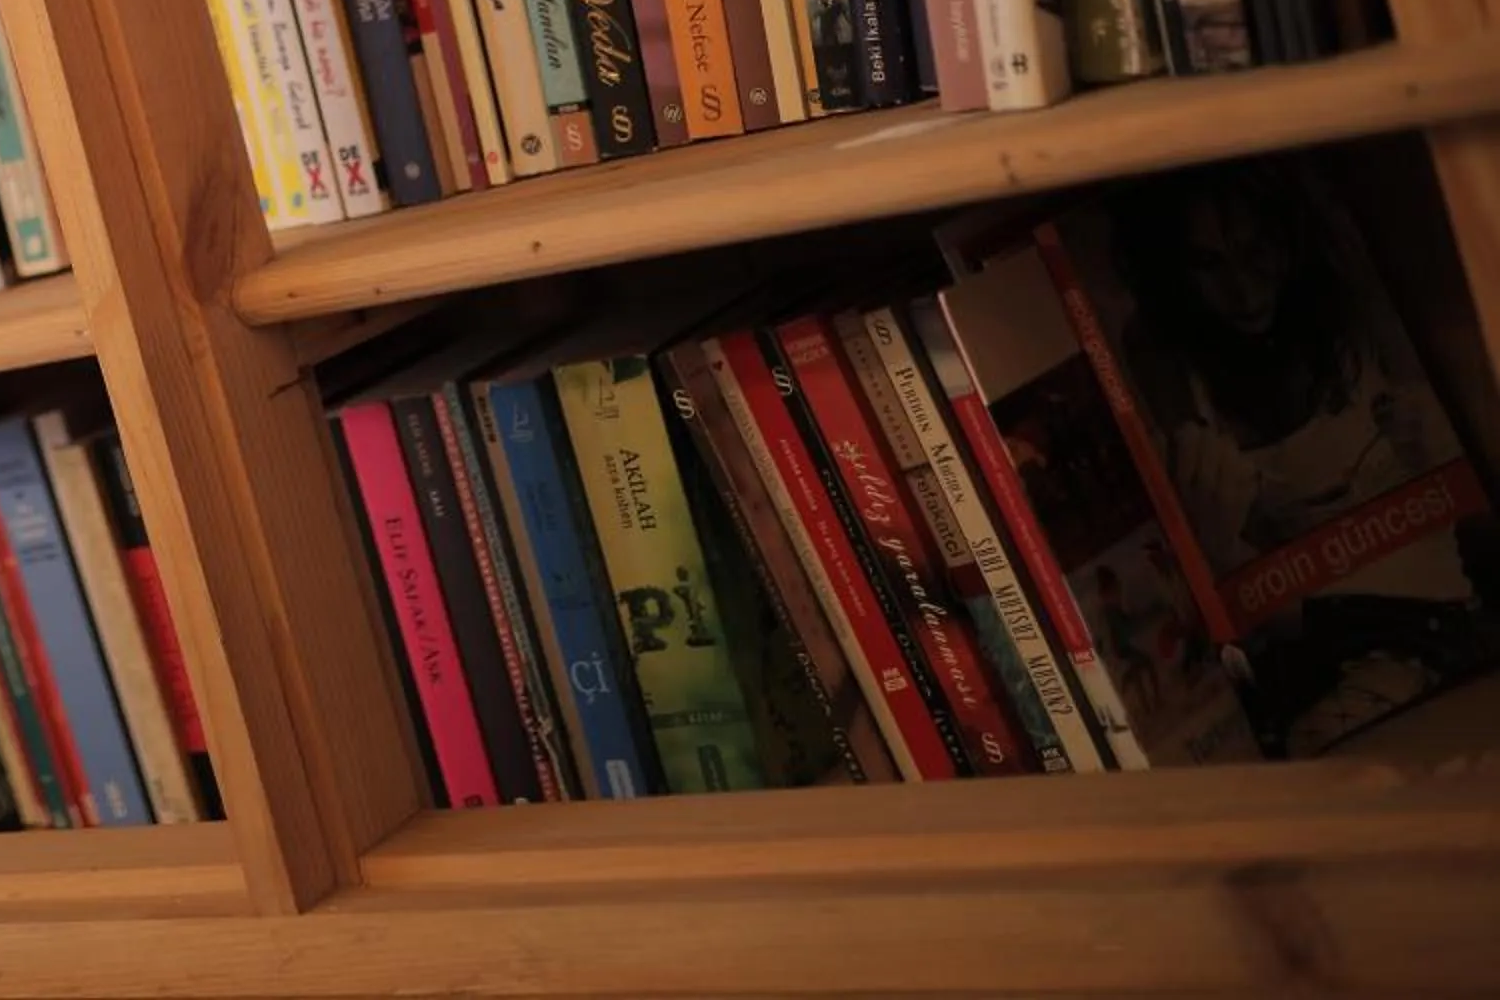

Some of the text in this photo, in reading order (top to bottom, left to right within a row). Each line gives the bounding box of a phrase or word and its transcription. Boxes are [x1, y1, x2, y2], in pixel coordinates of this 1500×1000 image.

[682, 0, 718, 75] Nefese
[865, 44, 886, 82] Beki
[1231, 473, 1462, 615] eroin güncesi
